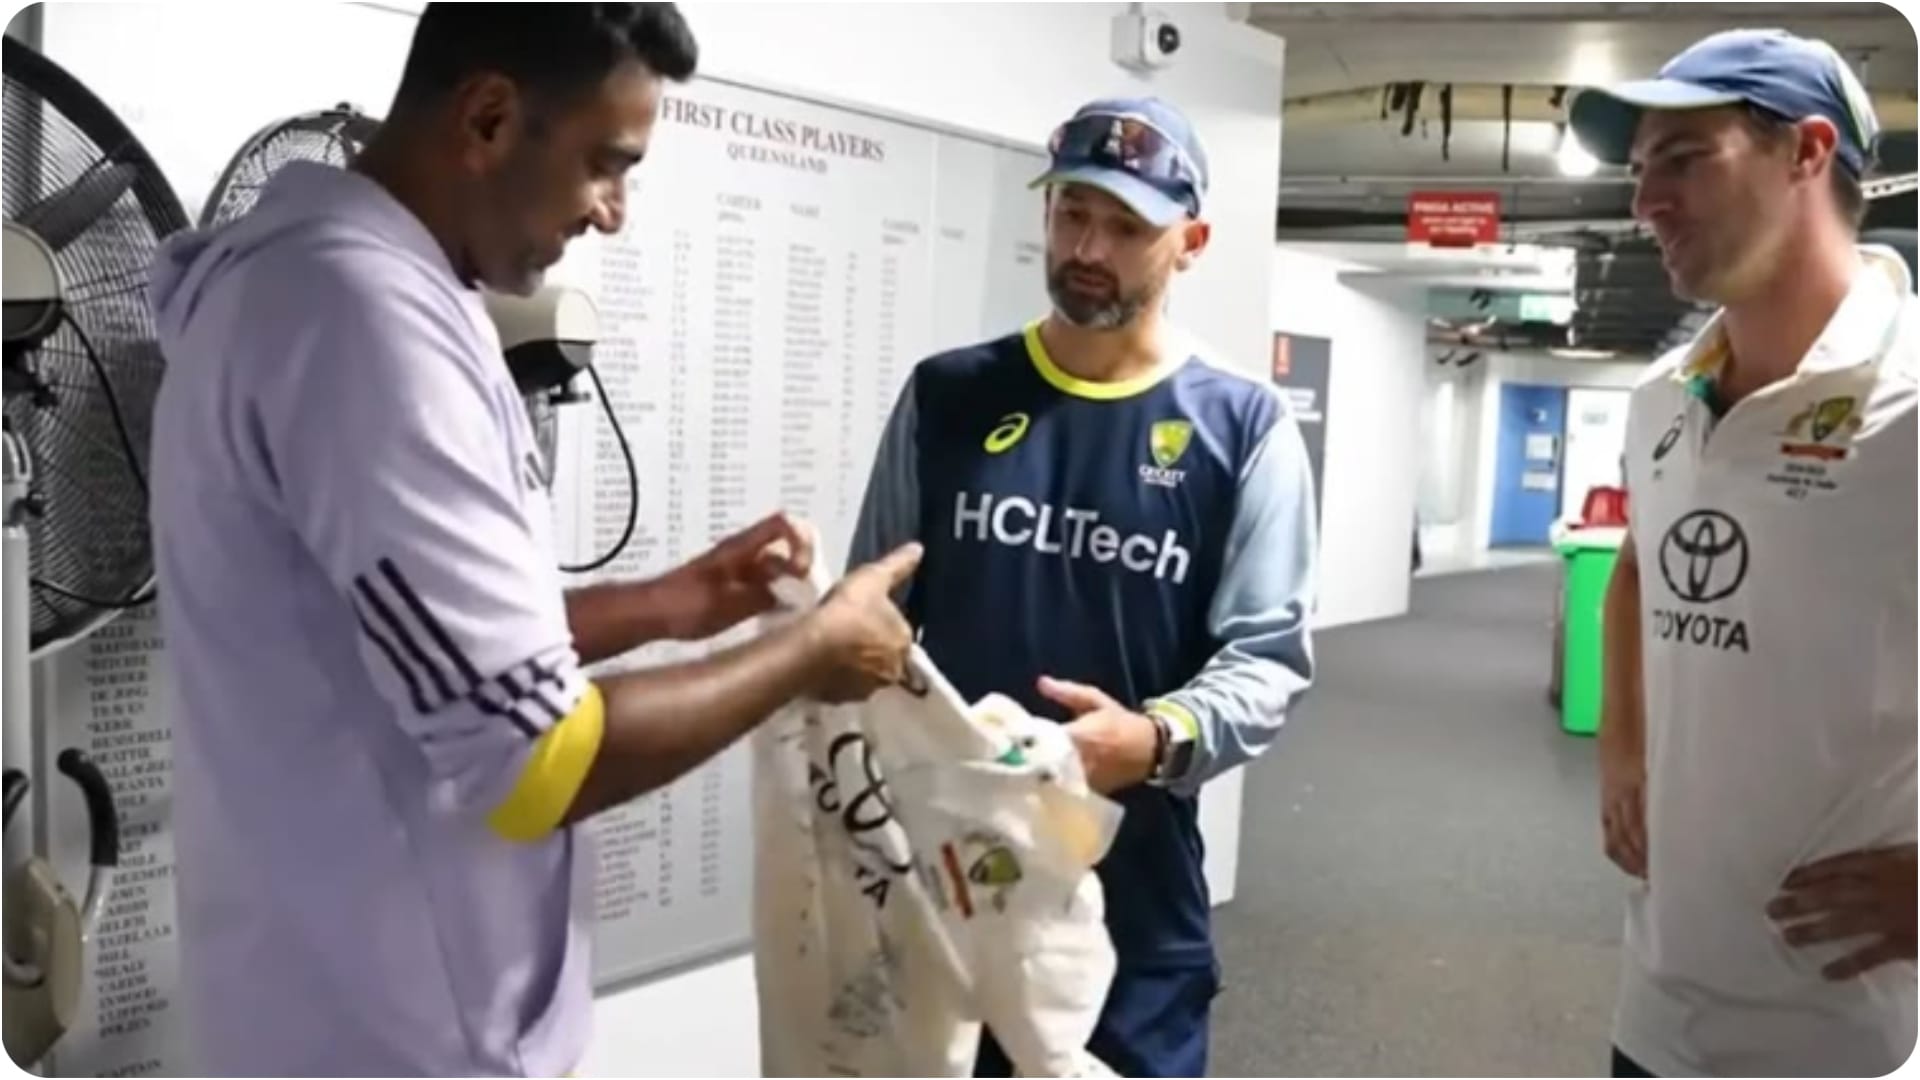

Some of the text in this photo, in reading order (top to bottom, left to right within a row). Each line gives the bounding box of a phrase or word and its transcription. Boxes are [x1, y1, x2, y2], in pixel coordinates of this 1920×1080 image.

[662, 97, 886, 163] FIRST CLASS PLAYERS
[726, 142, 828, 175] QUEENSLAND
[954, 491, 1191, 584] HCLTech
[1652, 609, 1750, 653] TOYOTA
